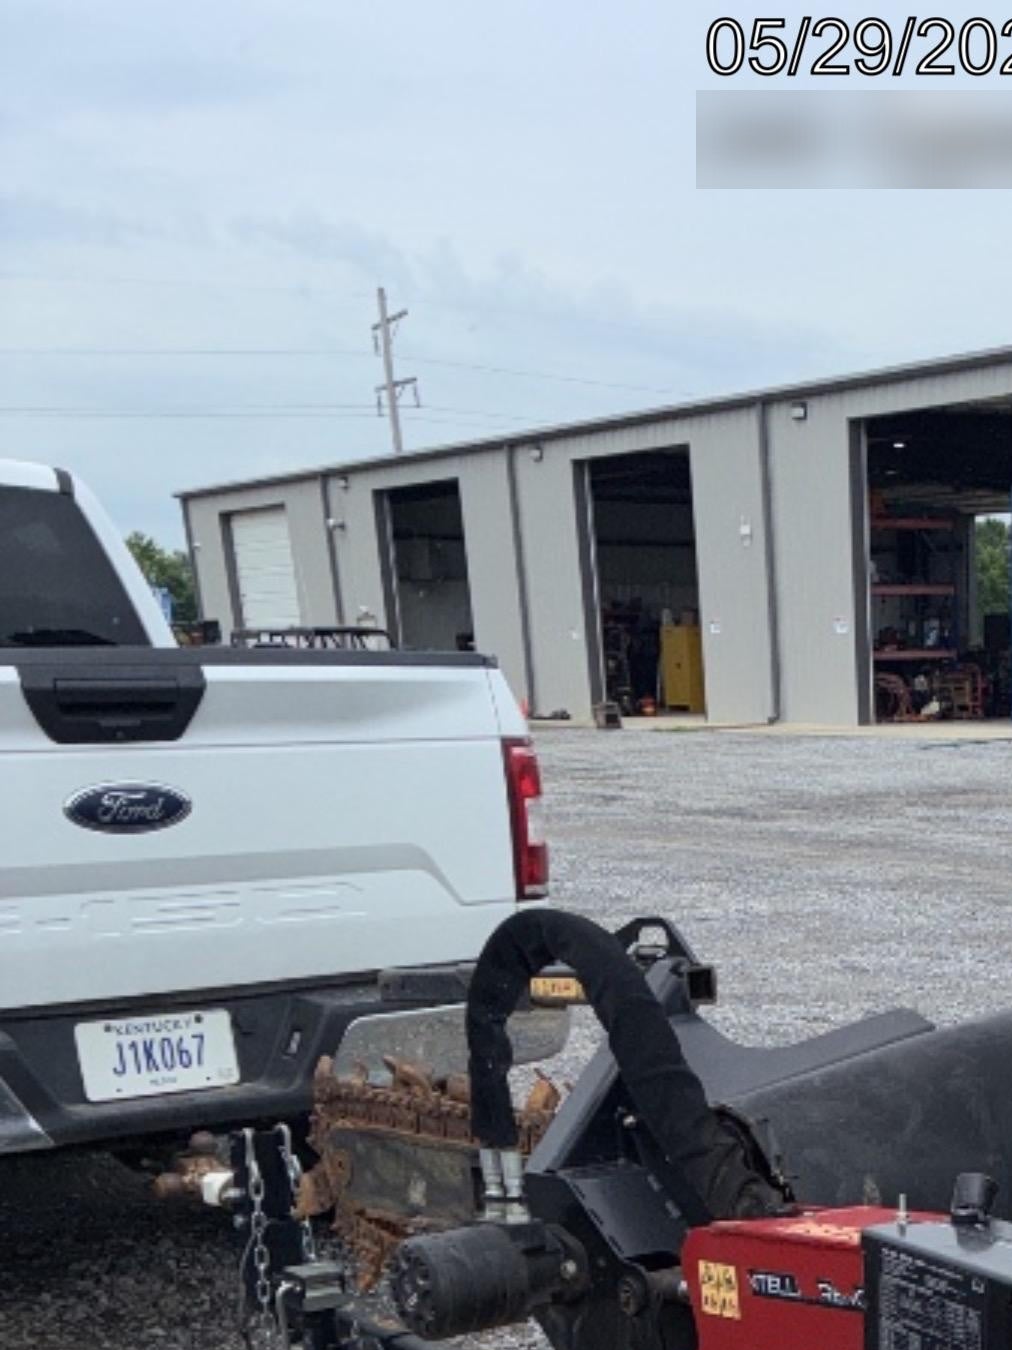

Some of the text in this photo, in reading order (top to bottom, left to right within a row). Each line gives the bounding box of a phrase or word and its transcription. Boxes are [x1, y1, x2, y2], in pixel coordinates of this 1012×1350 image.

[98, 790, 166, 822] Ford
[113, 1018, 192, 1036] KENTUCKY
[112, 1032, 205, 1077] J1K067
